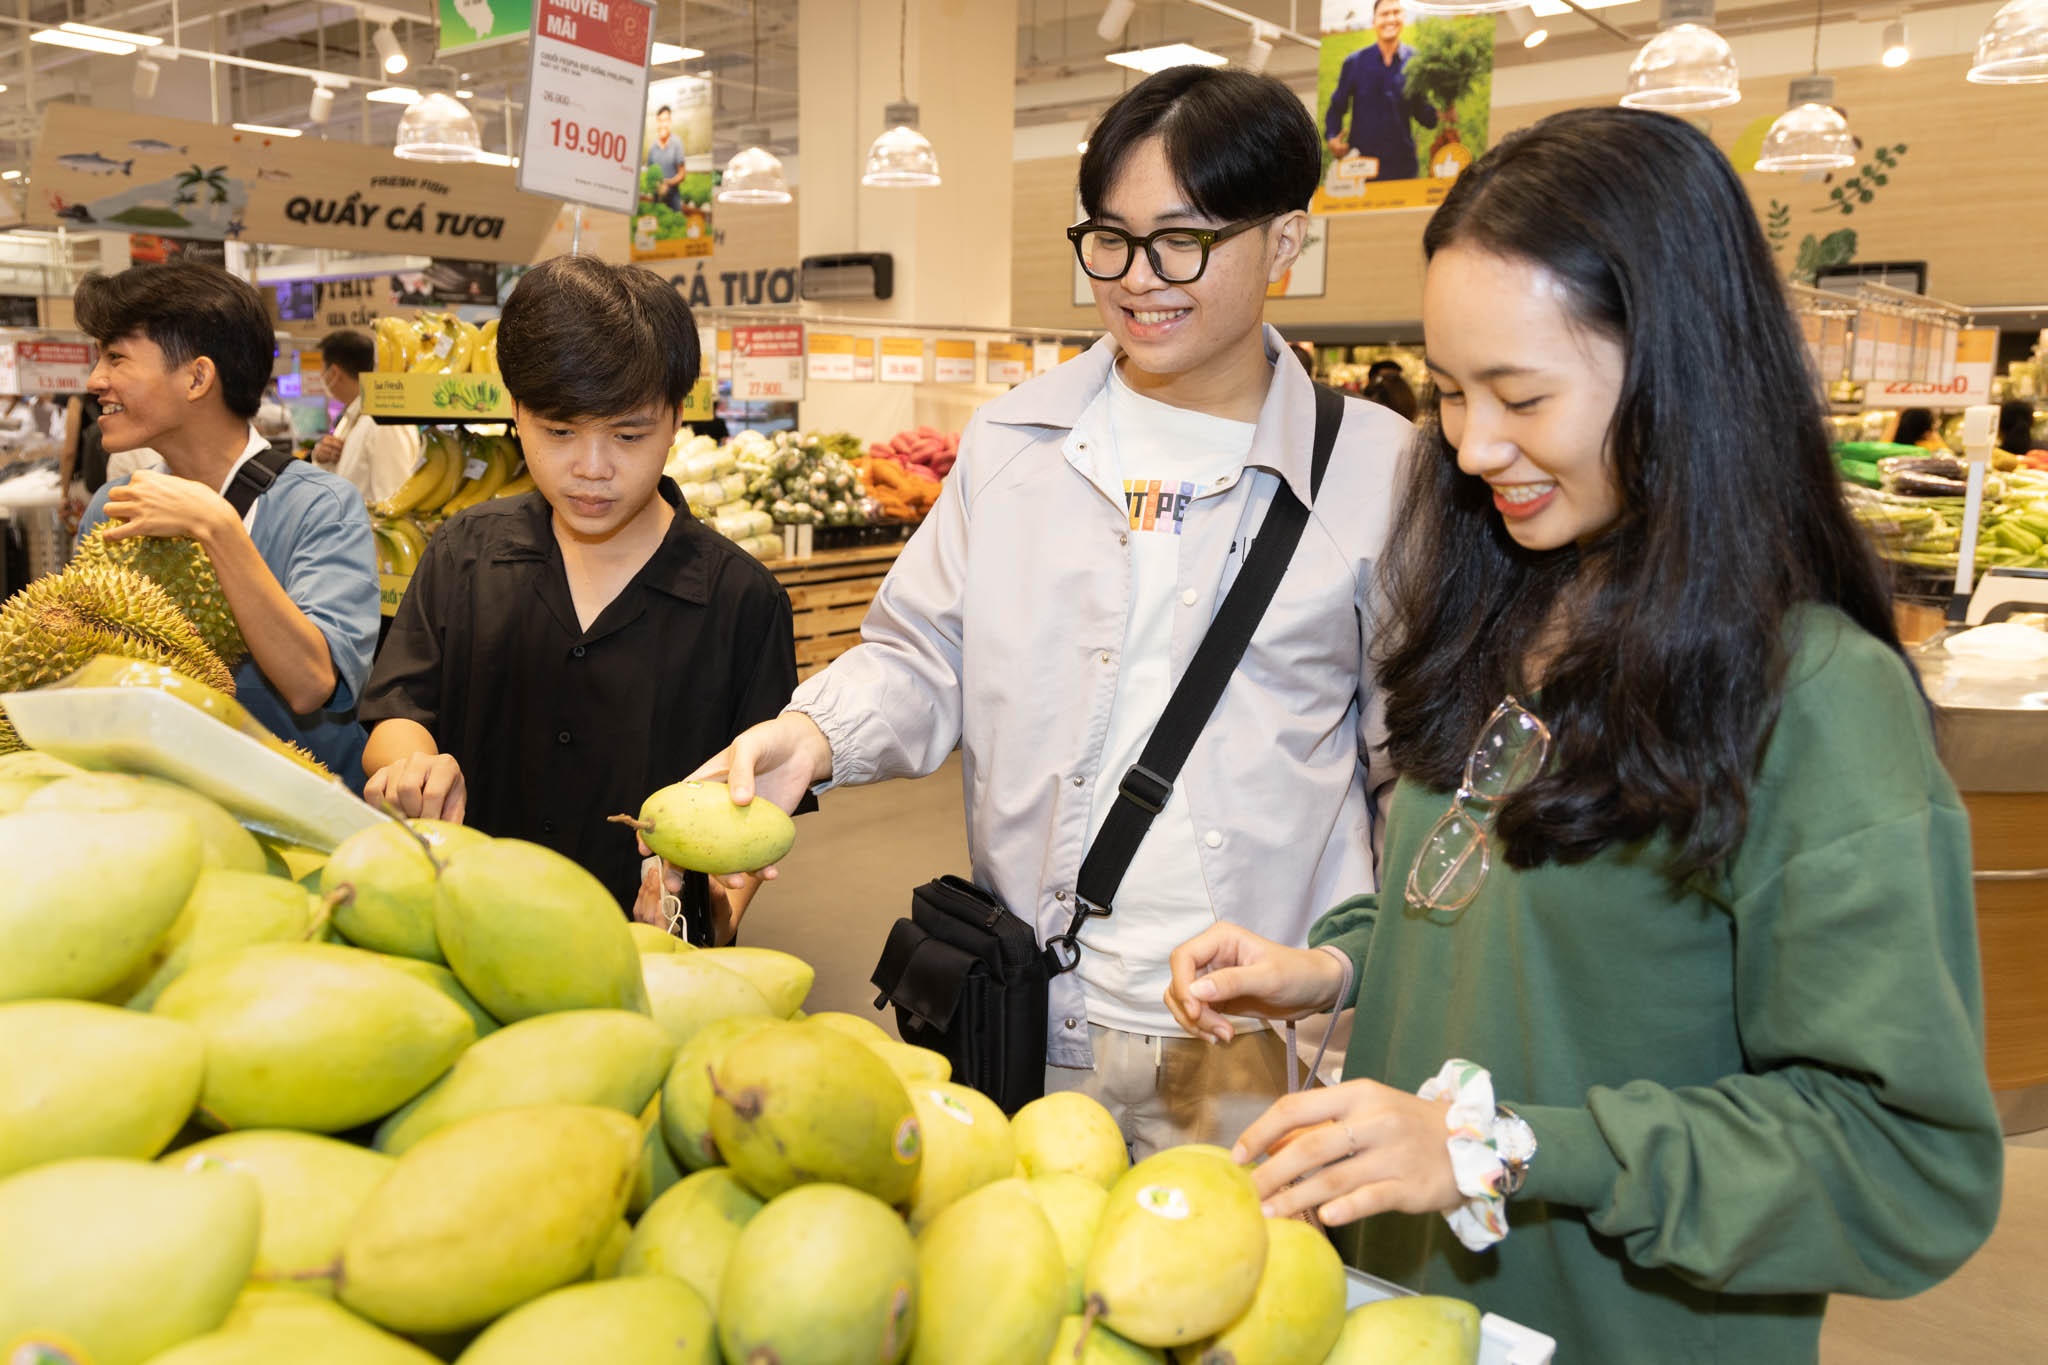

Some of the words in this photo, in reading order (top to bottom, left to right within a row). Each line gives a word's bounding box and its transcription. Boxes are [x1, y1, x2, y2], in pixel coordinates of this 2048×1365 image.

[546, 14, 578, 40] MÃI
[551, 118, 627, 163] 19.900
[370, 175, 417, 188] FRESH
[419, 178, 451, 195] FISH
[385, 202, 426, 234] CÁ
[435, 211, 505, 240] TƯƠI
